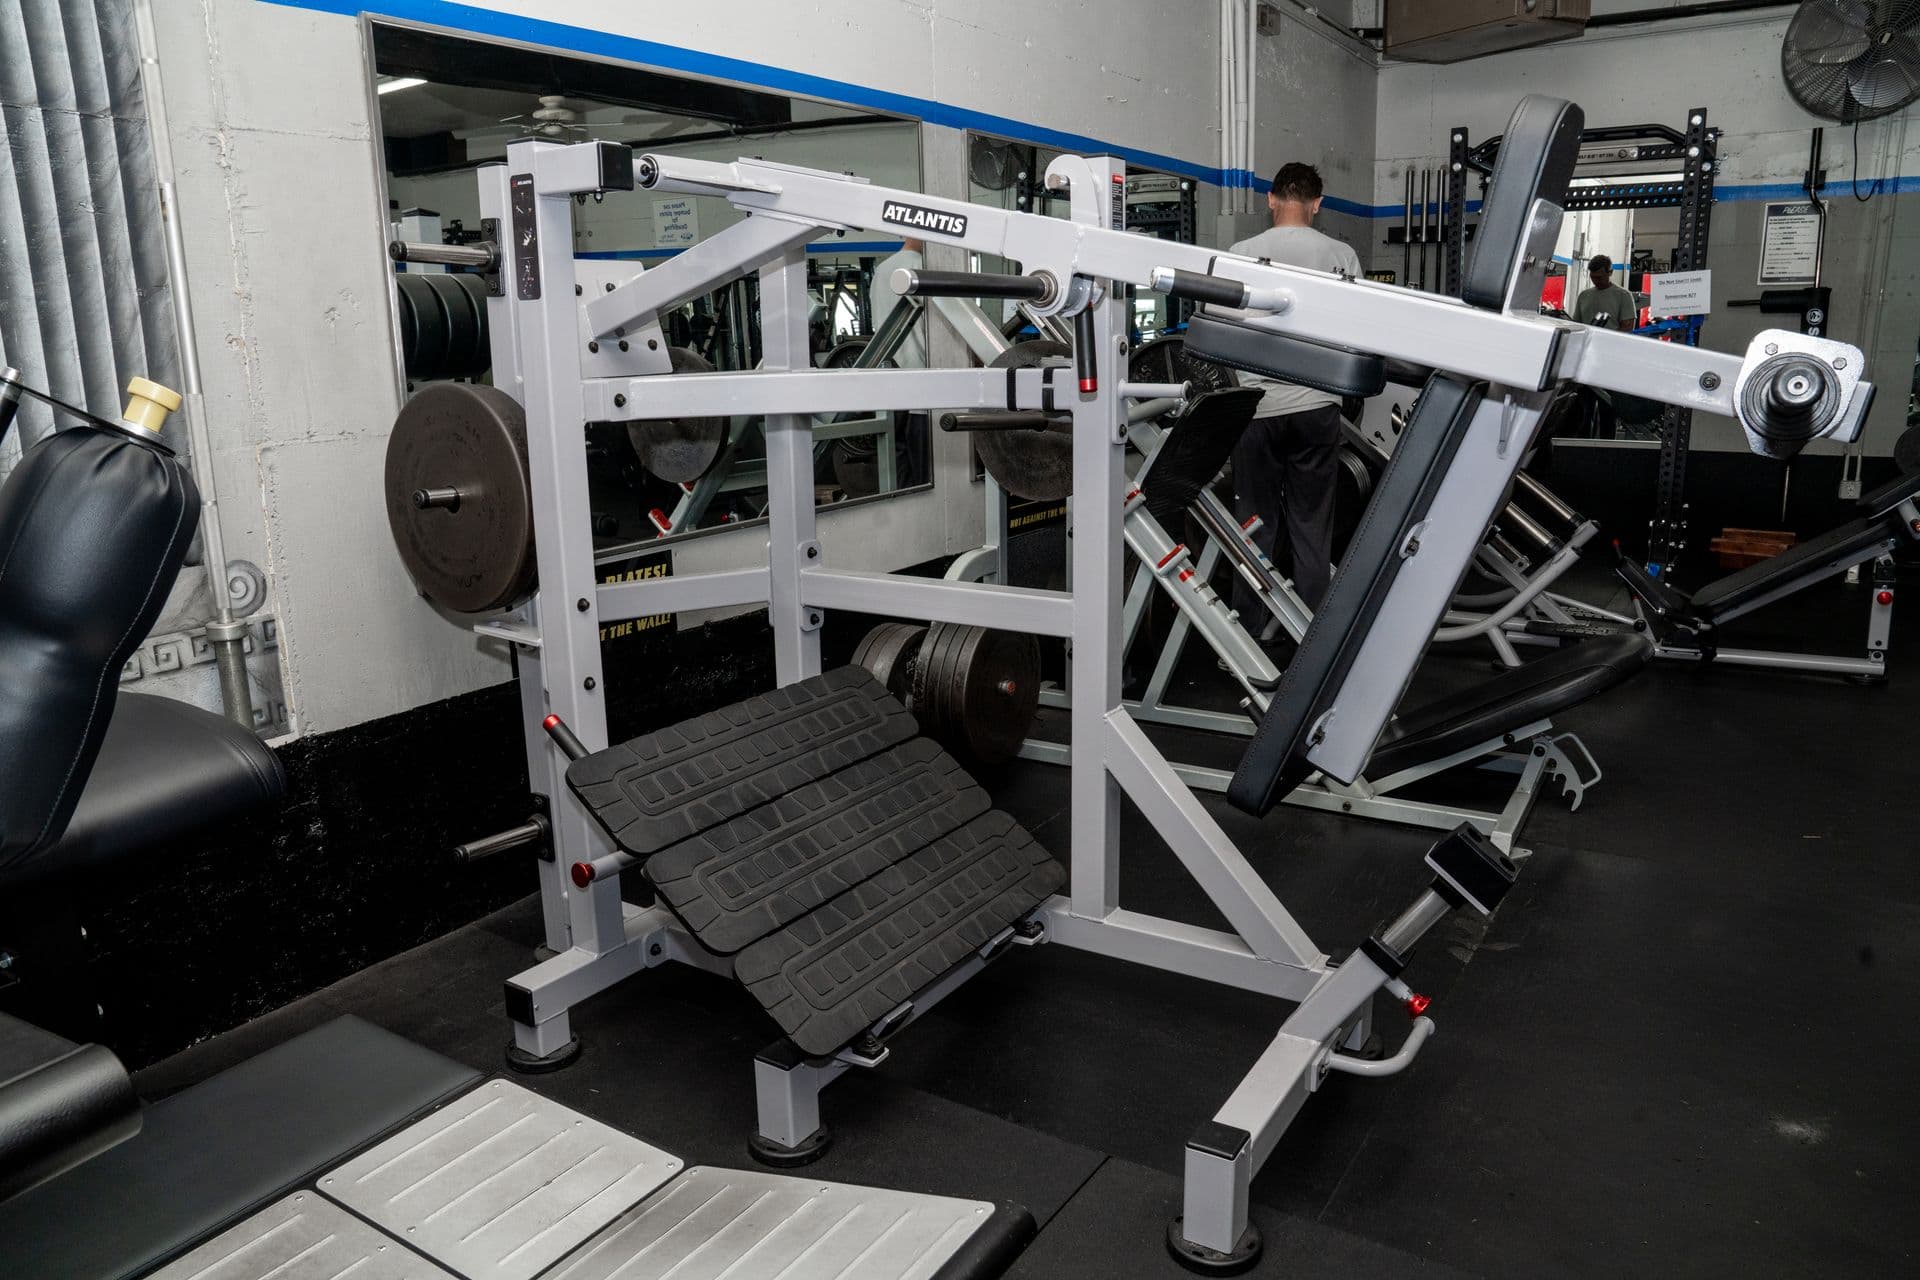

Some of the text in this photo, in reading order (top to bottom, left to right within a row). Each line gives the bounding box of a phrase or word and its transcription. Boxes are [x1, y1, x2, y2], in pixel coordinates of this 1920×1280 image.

[883, 204, 965, 234] ATLANTIS
[1782, 205, 1810, 214] PLEASE
[609, 621, 633, 639] THE
[636, 612, 672, 632] WALL!
